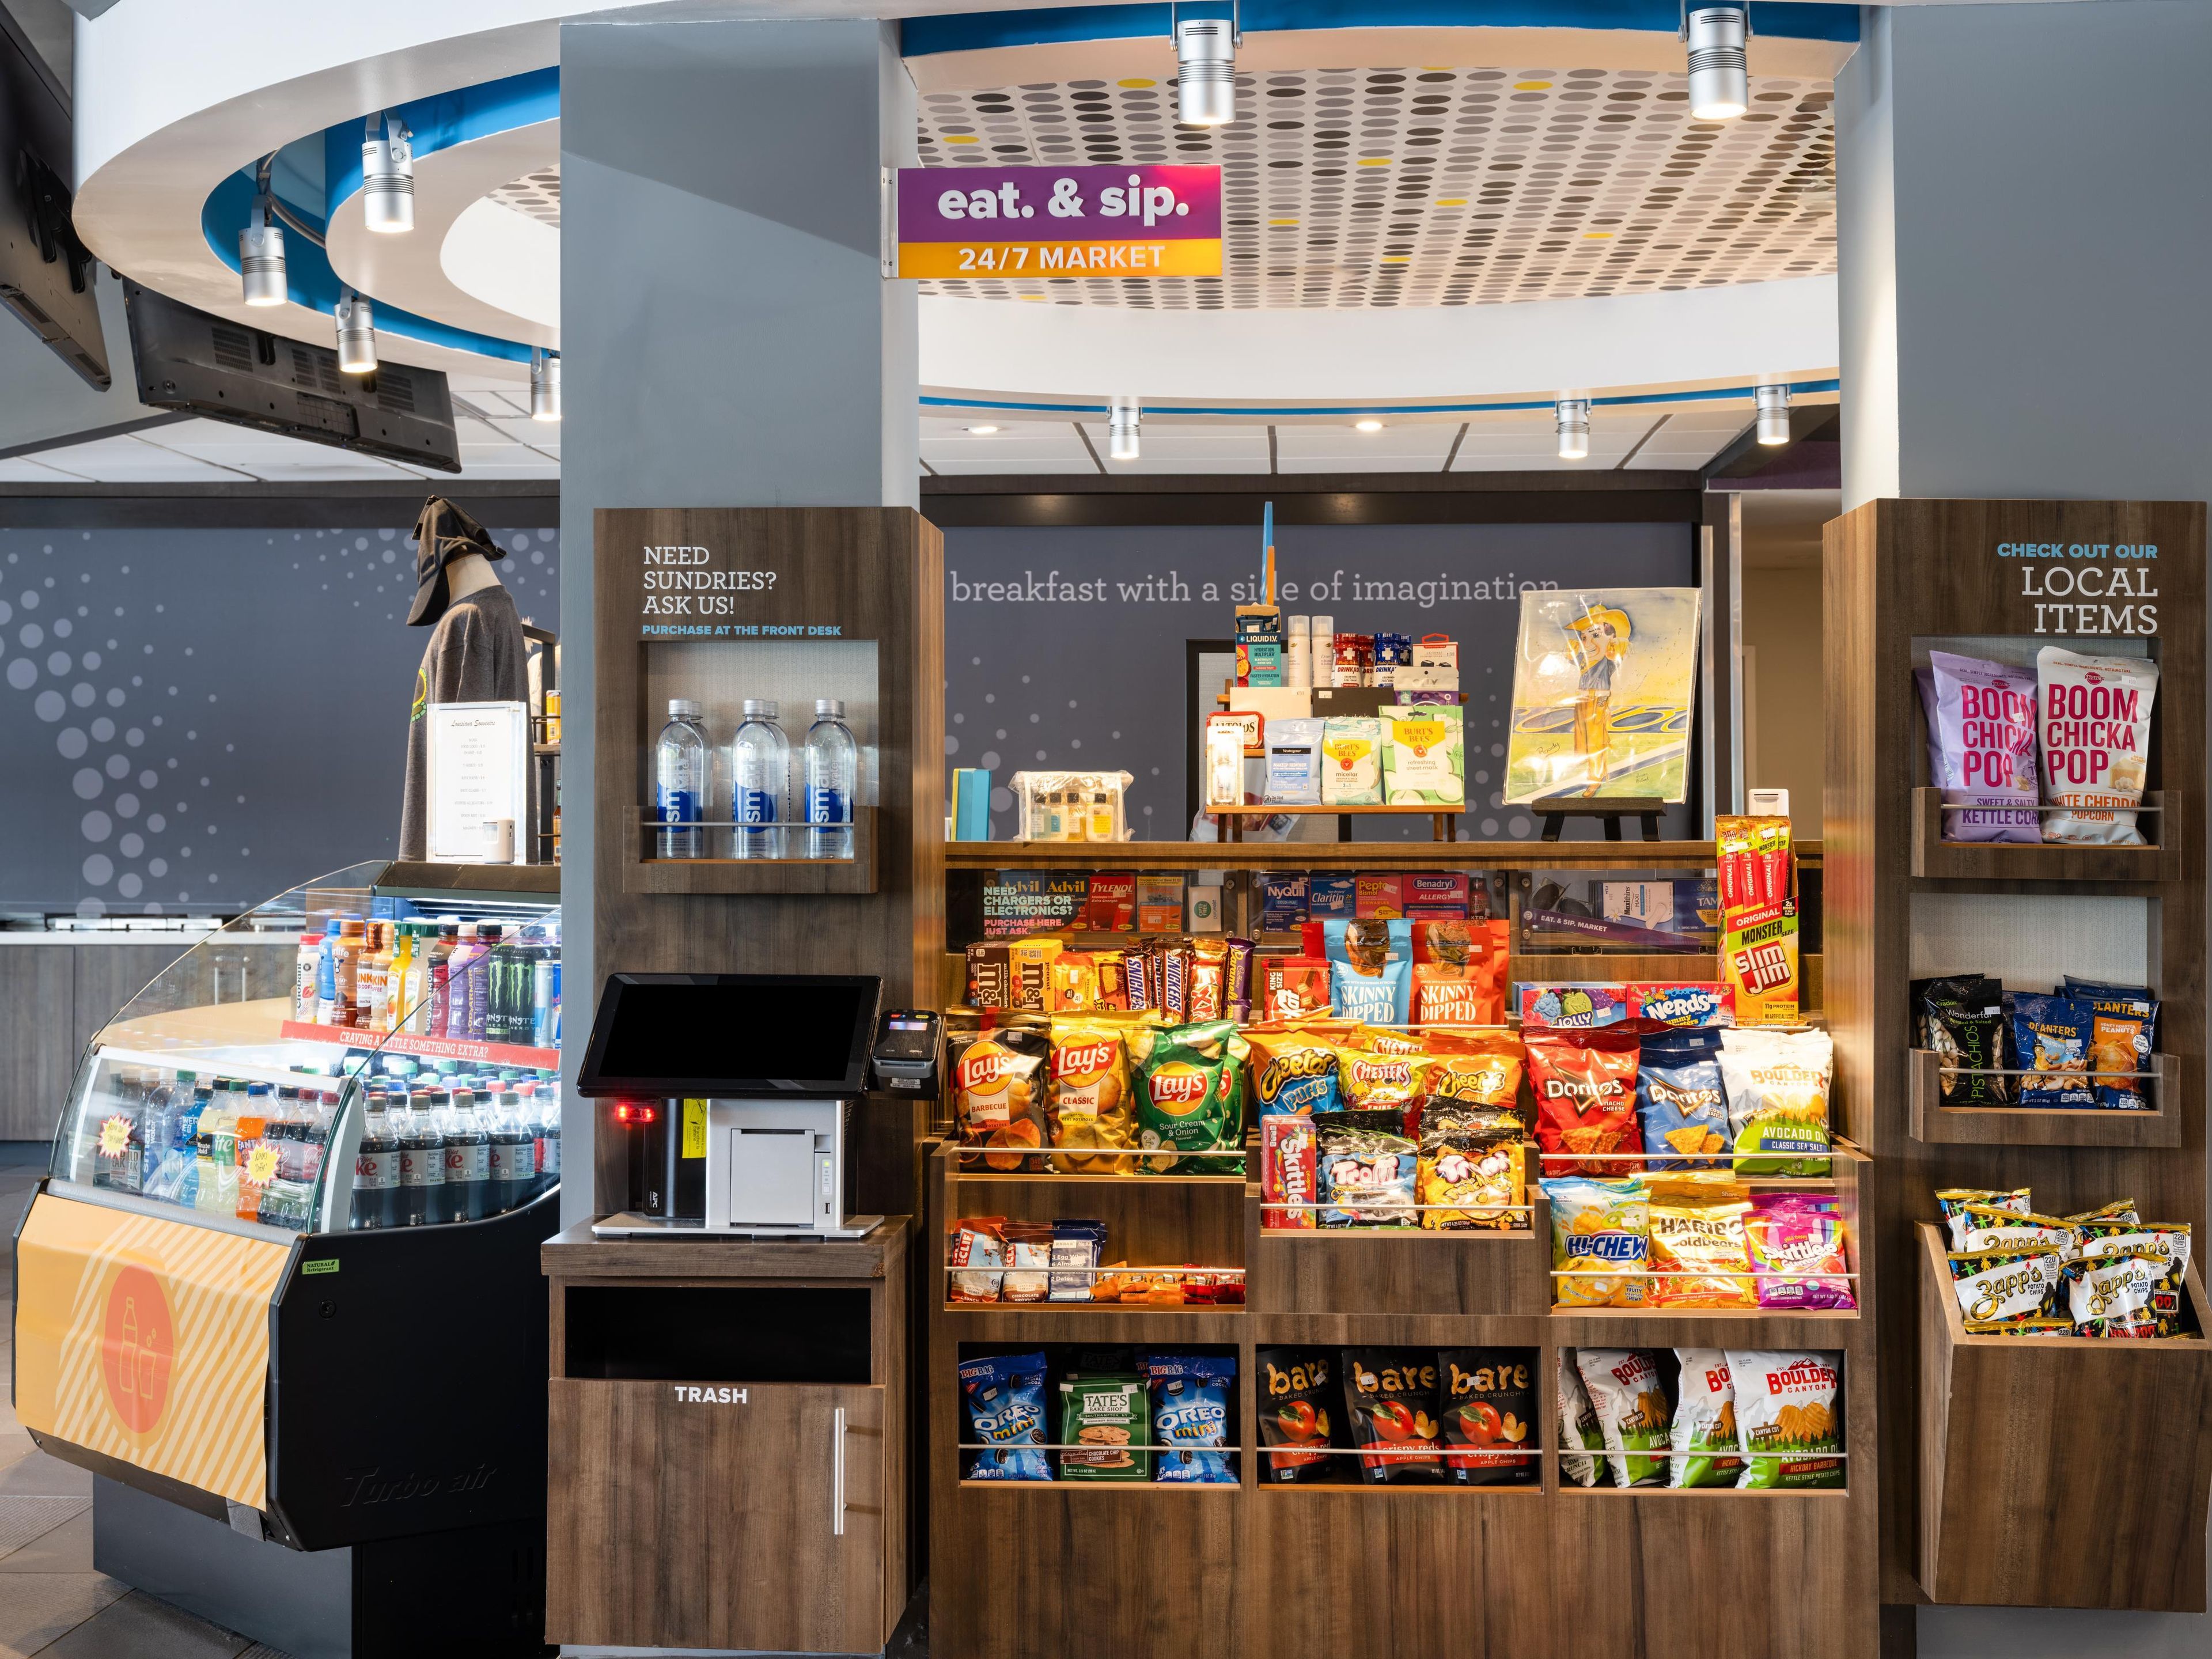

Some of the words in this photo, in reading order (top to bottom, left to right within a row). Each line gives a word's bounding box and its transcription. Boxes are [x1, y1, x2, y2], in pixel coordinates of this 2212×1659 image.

[938, 182, 1034, 219] eat.
[1048, 177, 1085, 218] &
[1100, 174, 1189, 226] sip.
[959, 247, 1029, 271] 24/7
[1040, 245, 1165, 269] MARKET
[643, 547, 709, 565] NEED
[1997, 543, 2063, 558] CHECK
[2069, 544, 2110, 558] OUT
[2115, 544, 2158, 559] OUR
[644, 572, 777, 590] SUNDRIES?
[950, 571, 1107, 603] breakfast
[1116, 571, 1191, 602] with
[1202, 582, 1220, 602] a
[1310, 571, 1344, 601] of
[2022, 566, 2158, 597] LOCAL
[642, 596, 691, 615] ASK
[698, 596, 734, 615] US!
[2034, 604, 2157, 634] ITEMS
[642, 625, 711, 635] PURCHASE
[714, 626, 731, 635] AT
[734, 626, 759, 635] THE
[762, 626, 804, 635] FRONT
[808, 626, 842, 636] DESK
[2048, 684, 2138, 724] BOOM
[2047, 721, 2136, 752] CHICKA
[1963, 751, 2013, 787] POP
[2047, 749, 2108, 786] POP
[815, 757, 830, 823] smart
[1963, 809, 2012, 824] KETTLE
[984, 887, 1017, 895] NEED
[1046, 880, 1085, 892] Advil
[1417, 880, 1452, 890] Benadryl
[984, 896, 1051, 906] CHARGERS
[1054, 896, 1072, 905] OR
[984, 906, 1073, 915] ELECTRONICS?
[1578, 922, 1608, 932] MARKET
[1736, 908, 1780, 927] ORIGINAL
[1742, 920, 1782, 945] MONSTER
[1781, 929, 1794, 937] SIZE
[1341, 986, 1396, 1002] SKINNY
[1421, 985, 1477, 1002] SKINNY
[1421, 1001, 1476, 1022] DIPPED
[340, 1032, 373, 1045] CRAVING
[374, 1036, 381, 1045] A
[409, 1040, 456, 1056] SOMETHING
[457, 1045, 488, 1058] EXTRA?
[1057, 1042, 1109, 1077] Lay's
[964, 1052, 1011, 1088] Lay's
[1352, 1059, 1411, 1086] CHESTER'S
[1154, 1074, 1203, 1103] Lay's
[1547, 1080, 1624, 1099] Doritos
[1649, 1085, 1722, 1105] Doritos
[972, 1103, 1007, 1113] BARBECUE
[1063, 1097, 1094, 1105] CLASSIC
[1763, 1127, 1812, 1140] AVOCADO
[1772, 1141, 1795, 1149] CLASSIC
[1810, 1143, 1823, 1152] SALT
[1281, 1139, 1304, 1220] Skittles
[959, 1234, 972, 1259] CLIF
[1566, 1234, 1649, 1262] HI-CHEW
[960, 1369, 978, 1378] BIG
[978, 1365, 994, 1374] BAG
[1150, 1365, 1166, 1375] BIG
[1167, 1365, 1183, 1374] BAG
[1354, 1362, 1438, 1393] bare
[1450, 1363, 1529, 1395] bare
[1766, 1368, 1836, 1395] BOULDER
[1787, 1384, 1826, 1393] CANYON
[675, 1386, 748, 1404] TRASH
[1085, 1395, 1127, 1407] TATE'S
[974, 1405, 1039, 1431] OREO
[1156, 1407, 1225, 1430] OREO
[1790, 1464, 1811, 1472] HICKORY
[1813, 1458, 1838, 1469] BARBEQUE
